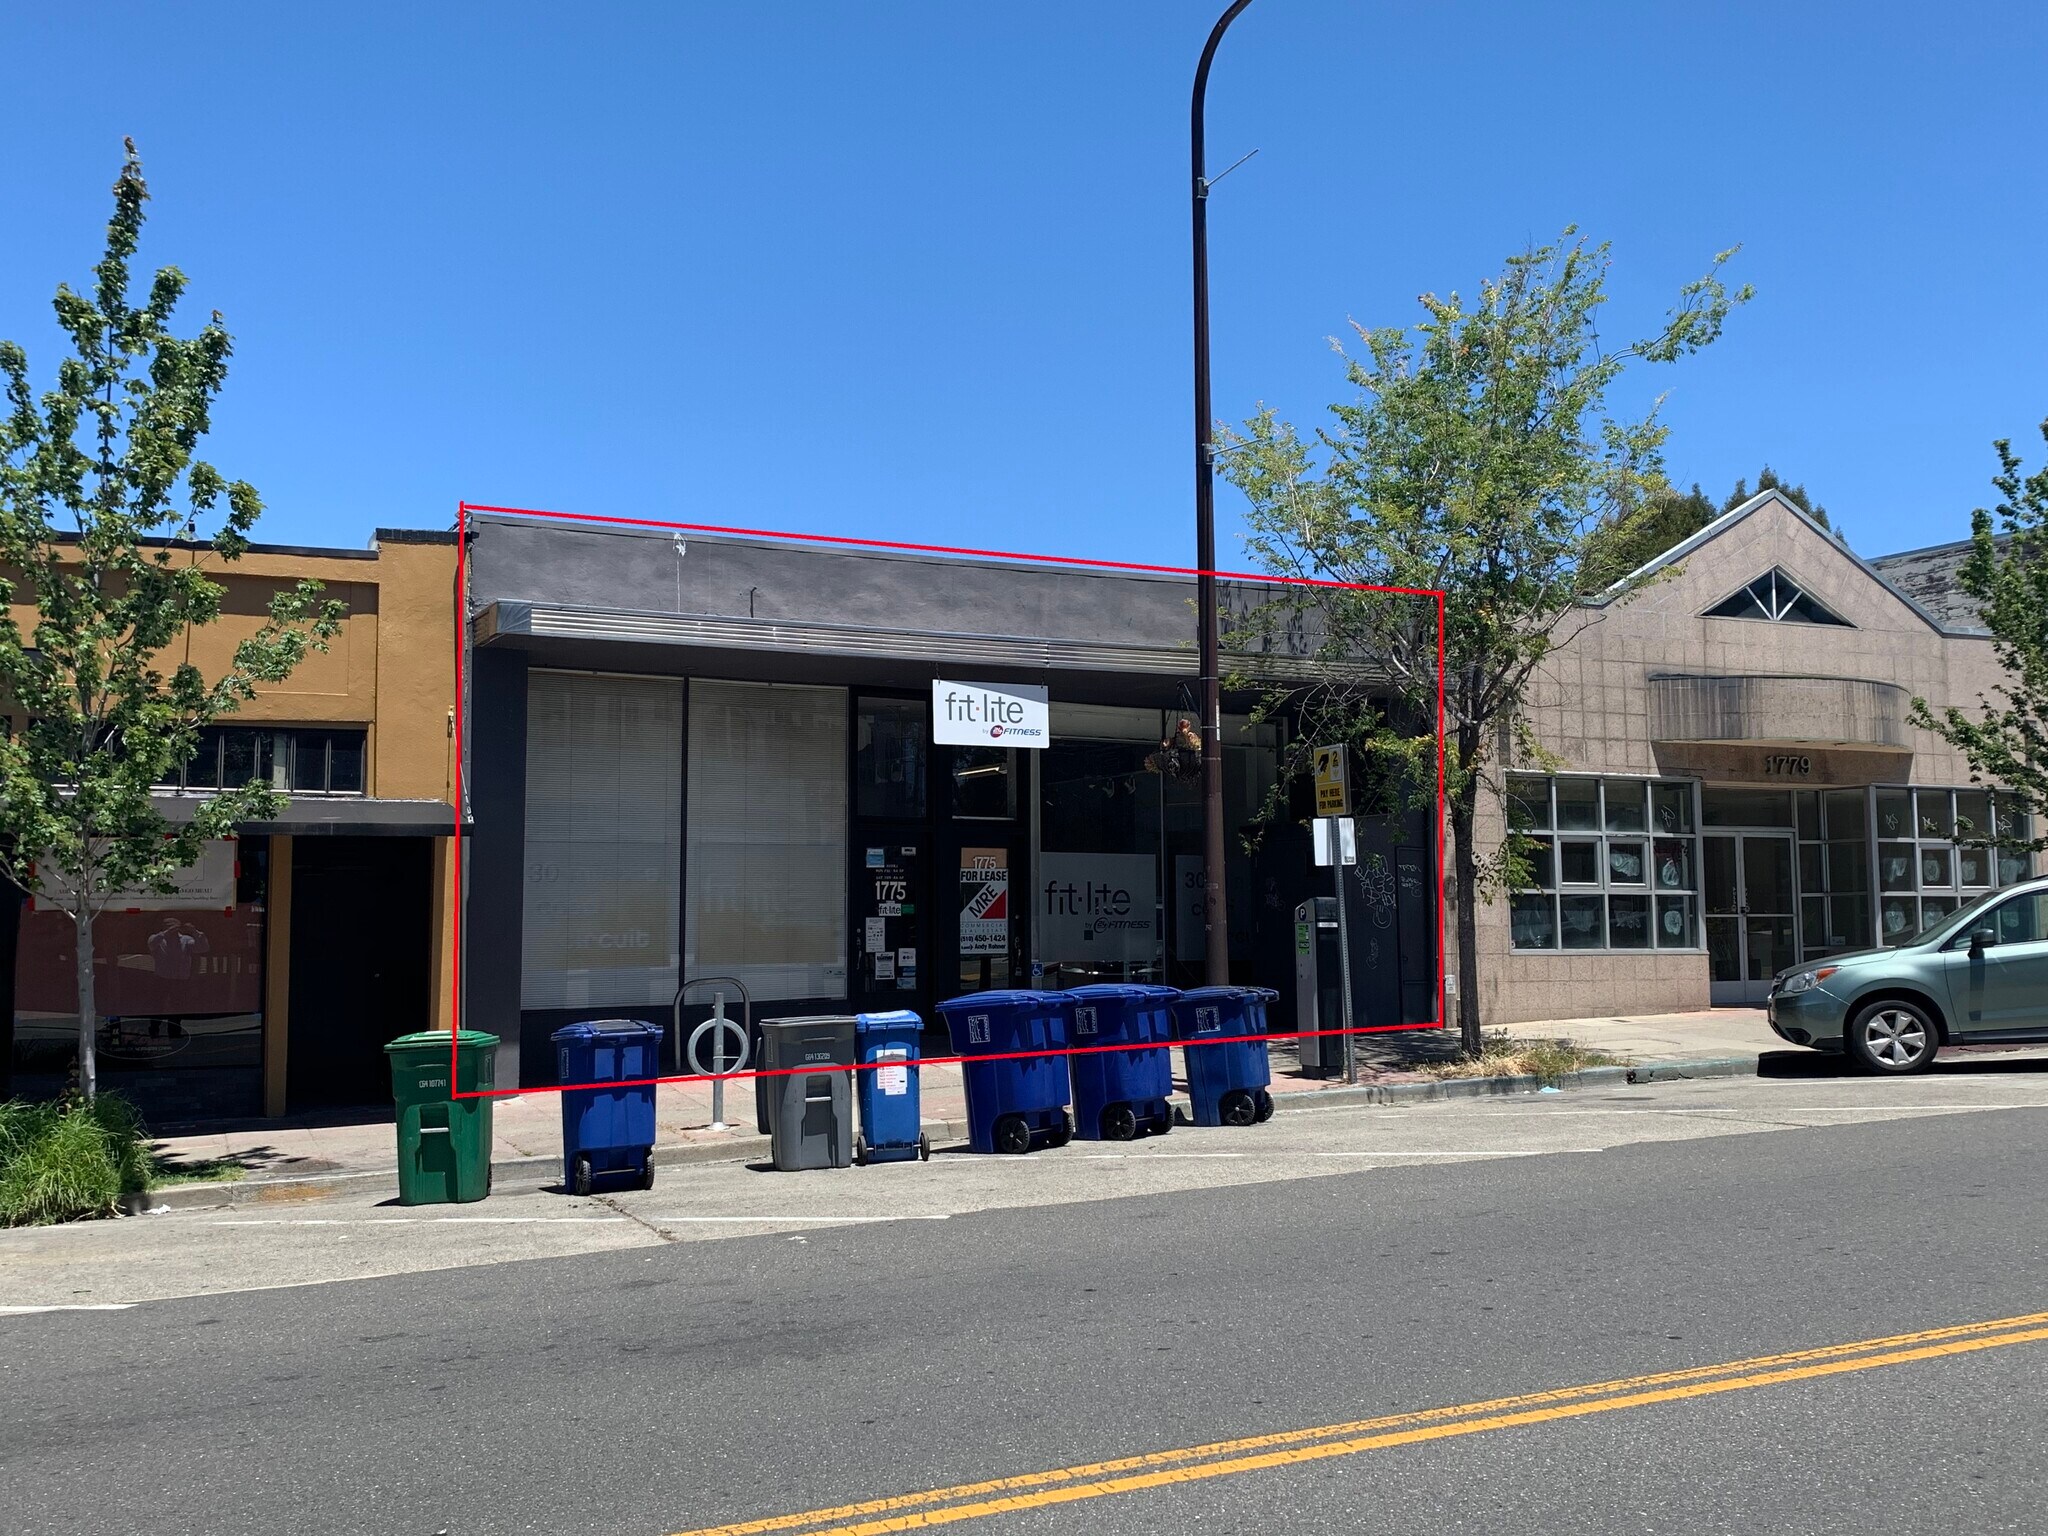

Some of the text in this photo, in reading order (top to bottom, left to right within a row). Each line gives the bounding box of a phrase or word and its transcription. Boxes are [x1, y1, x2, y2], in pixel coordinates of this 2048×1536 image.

[1003, 727, 1042, 736] FITNESS
[1766, 755, 1812, 776] 1779
[972, 856, 997, 869] 1775
[960, 870, 1007, 881] FOR LEASE
[875, 880, 907, 901] 1775
[968, 884, 998, 919] MRE
[1108, 920, 1152, 929] FITNESS
[974, 934, 1006, 942] 450-1424
